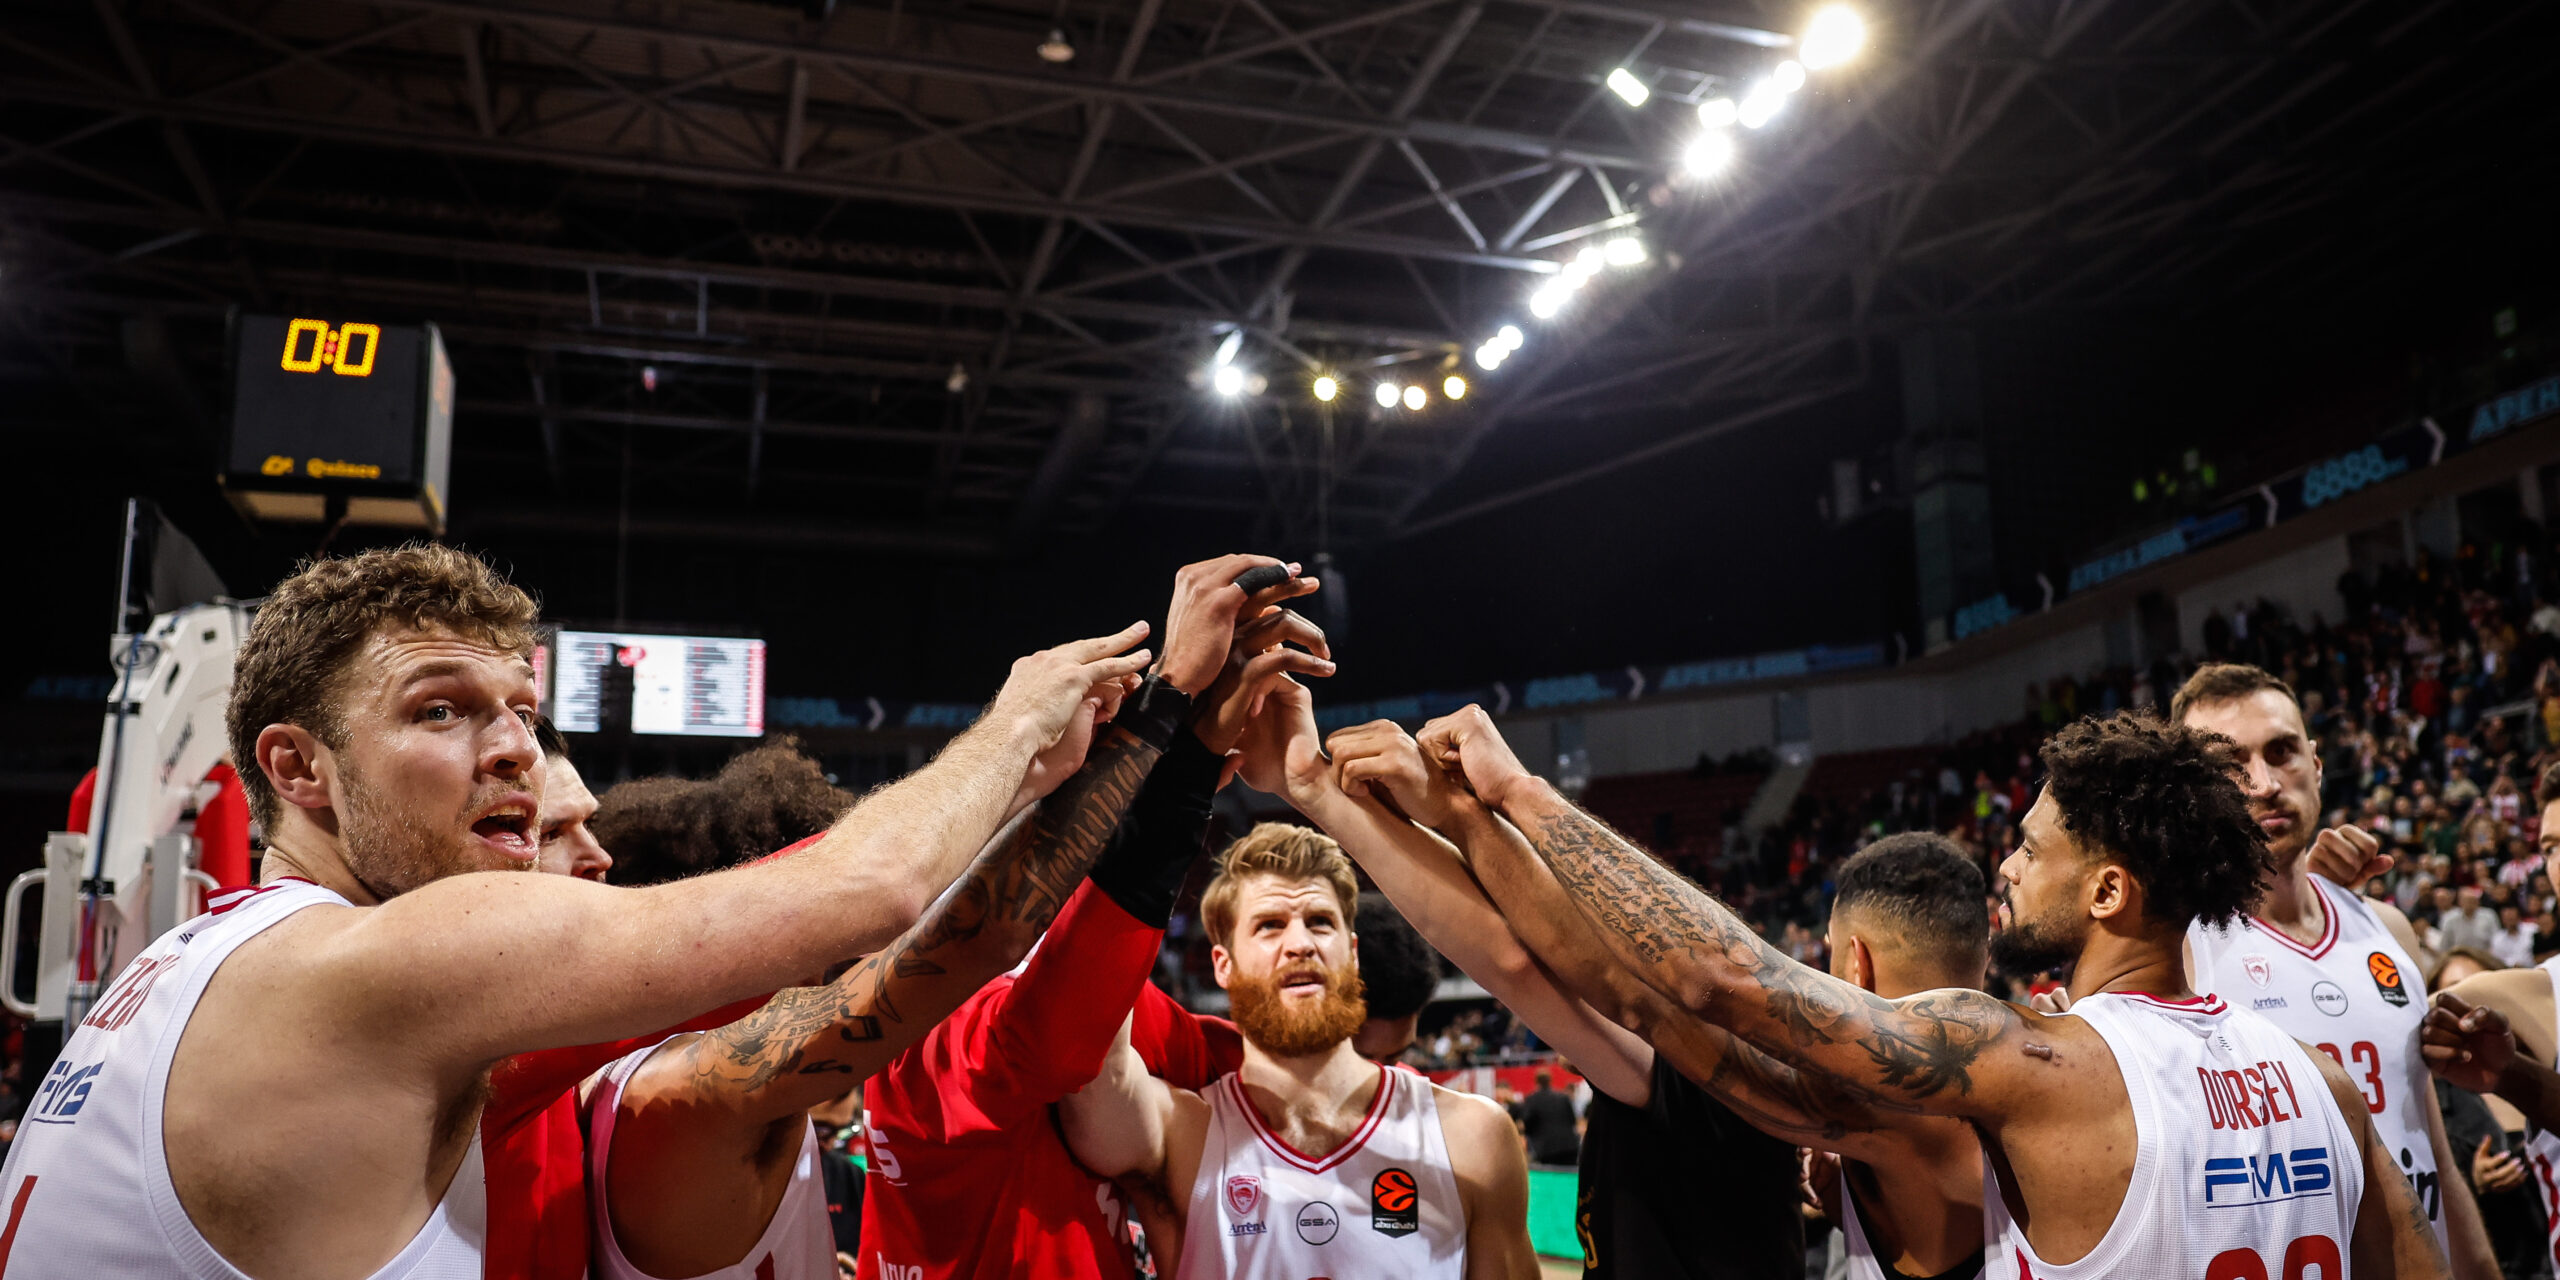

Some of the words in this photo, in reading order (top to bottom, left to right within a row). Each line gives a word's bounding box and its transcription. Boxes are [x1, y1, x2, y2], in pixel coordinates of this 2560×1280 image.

[281, 318, 381, 377] 0:0
[2197, 1061, 2302, 1131] DORSEY
[2205, 1147, 2332, 1203] FMS
[1299, 1218, 1337, 1227] GSA
